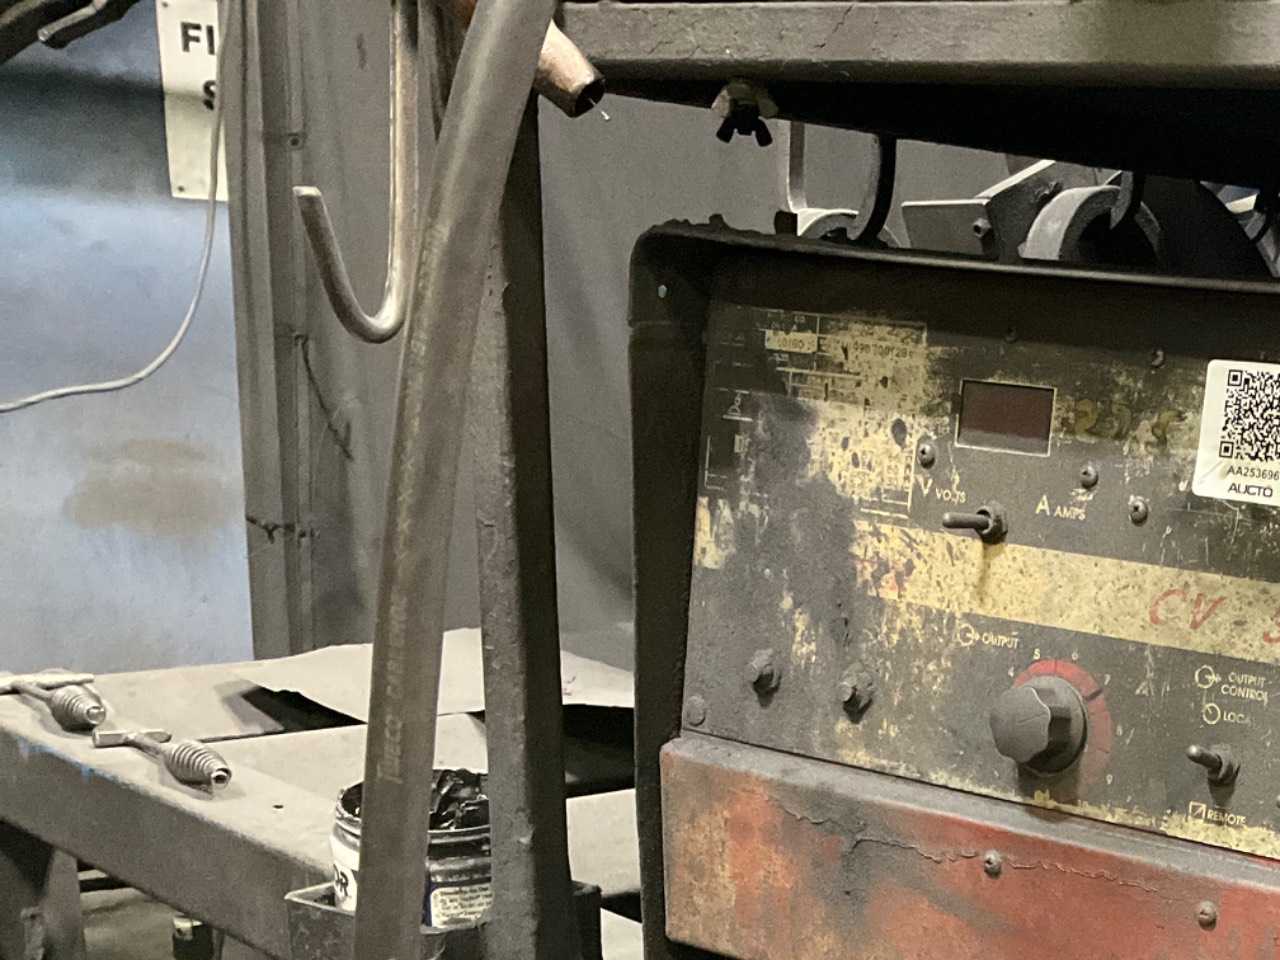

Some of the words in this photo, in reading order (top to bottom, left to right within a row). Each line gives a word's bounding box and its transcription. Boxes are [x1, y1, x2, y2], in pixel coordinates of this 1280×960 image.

[180, 21, 216, 55] FI
[1226, 465, 1280, 481] AA253696
[936, 488, 966, 503] VOLTS
[1228, 483, 1274, 498] AUCTO
[1036, 495, 1051, 516] A
[1054, 506, 1086, 521] AMPS
[982, 633, 1019, 648] OUTPUT
[1033, 648, 1041, 660] 5
[1228, 671, 1266, 688] OUTPUT
[1220, 683, 1269, 702] CONTROL
[1207, 808, 1247, 825] REMOTE
